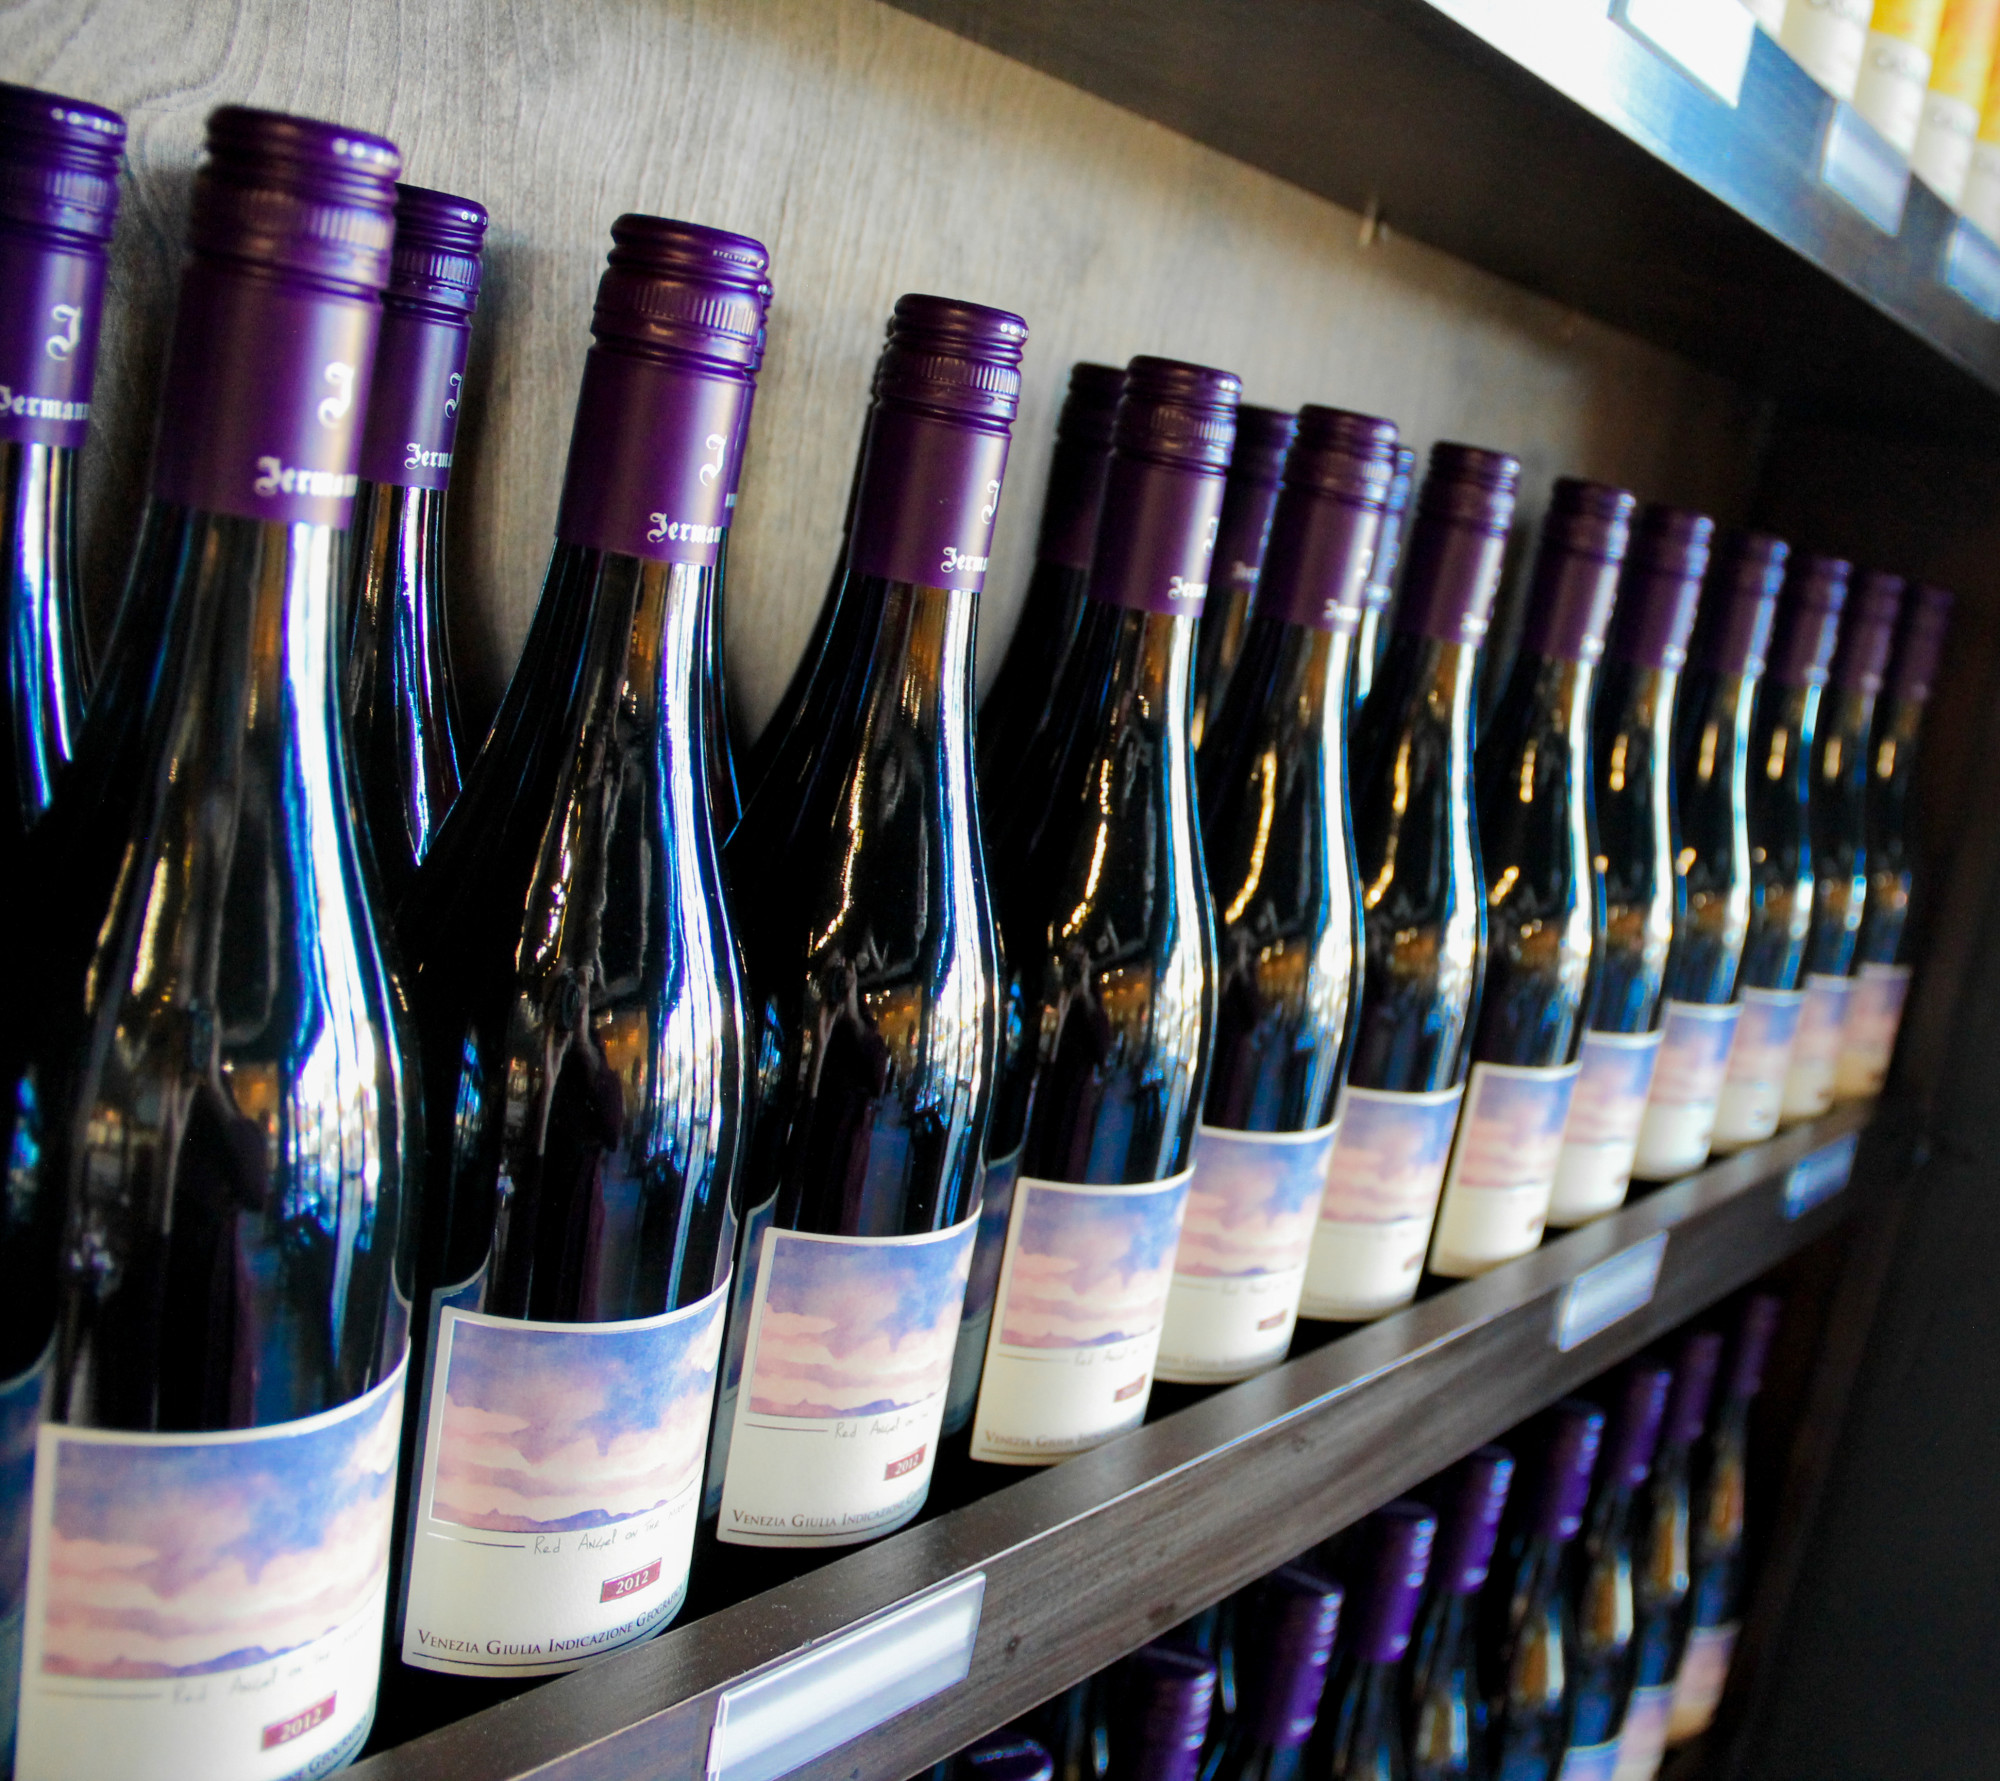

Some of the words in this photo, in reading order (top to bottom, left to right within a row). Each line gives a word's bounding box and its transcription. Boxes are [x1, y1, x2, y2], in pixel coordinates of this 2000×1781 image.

[534, 1535, 560, 1555] Red
[616, 1570, 649, 1595] 2012
[418, 1628, 480, 1654] VENEZIA
[486, 1639, 551, 1655] GIULIA
[548, 1620, 634, 1652] INDICAZIONE
[280, 1706, 323, 1742] 2012
